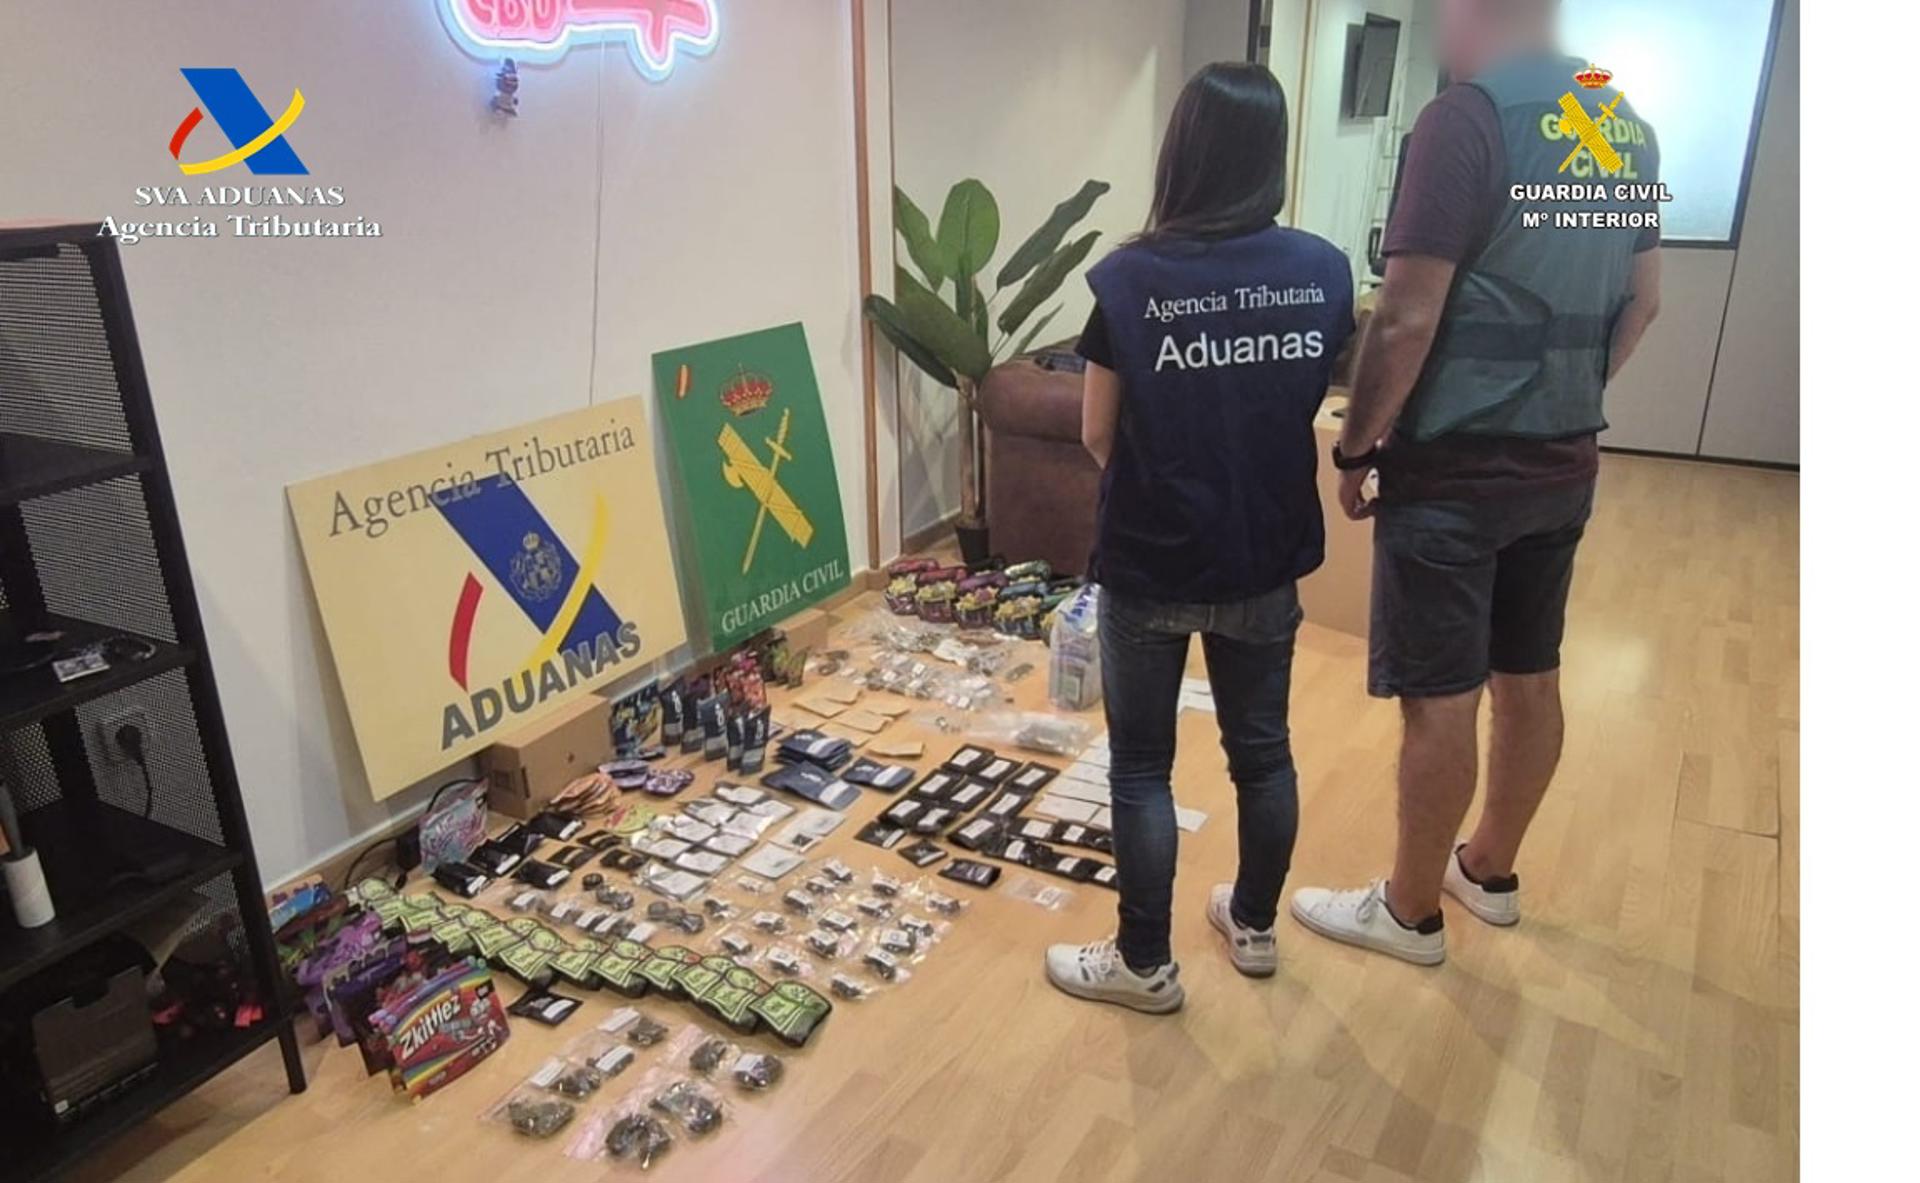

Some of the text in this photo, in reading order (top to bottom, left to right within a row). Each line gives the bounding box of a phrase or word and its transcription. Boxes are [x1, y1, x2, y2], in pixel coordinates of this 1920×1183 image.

[1144, 282, 1325, 322] Agencia Tributaria
[1155, 330, 1324, 372] Aduanas
[328, 418, 636, 539] Agencia Tributaria
[721, 560, 843, 633] GUARDIA CIVIL
[441, 621, 642, 751] ADUANAS
[400, 995, 462, 1060] Zkittlez
